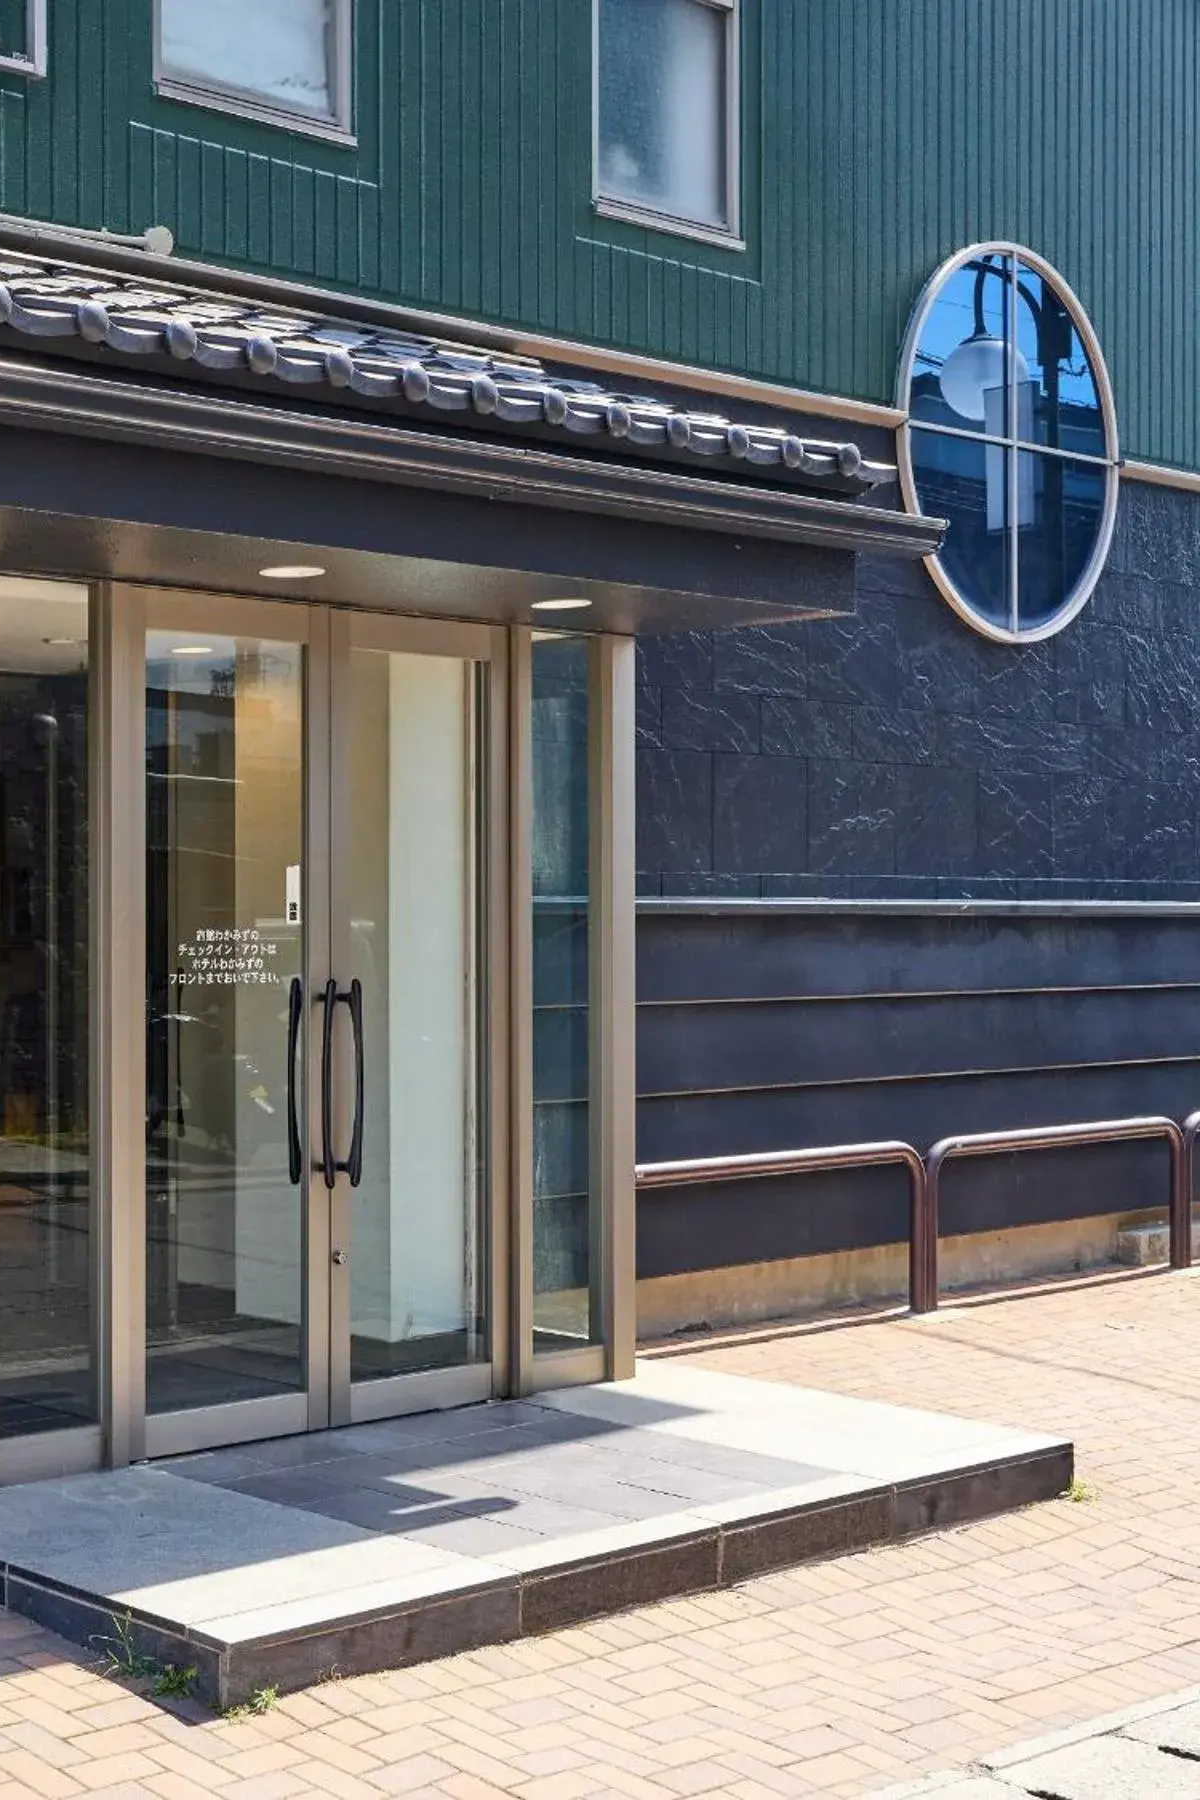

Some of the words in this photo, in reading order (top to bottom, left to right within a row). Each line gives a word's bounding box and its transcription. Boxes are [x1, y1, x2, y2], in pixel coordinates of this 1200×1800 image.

[191, 957, 264, 970] ホテルわかみずの
